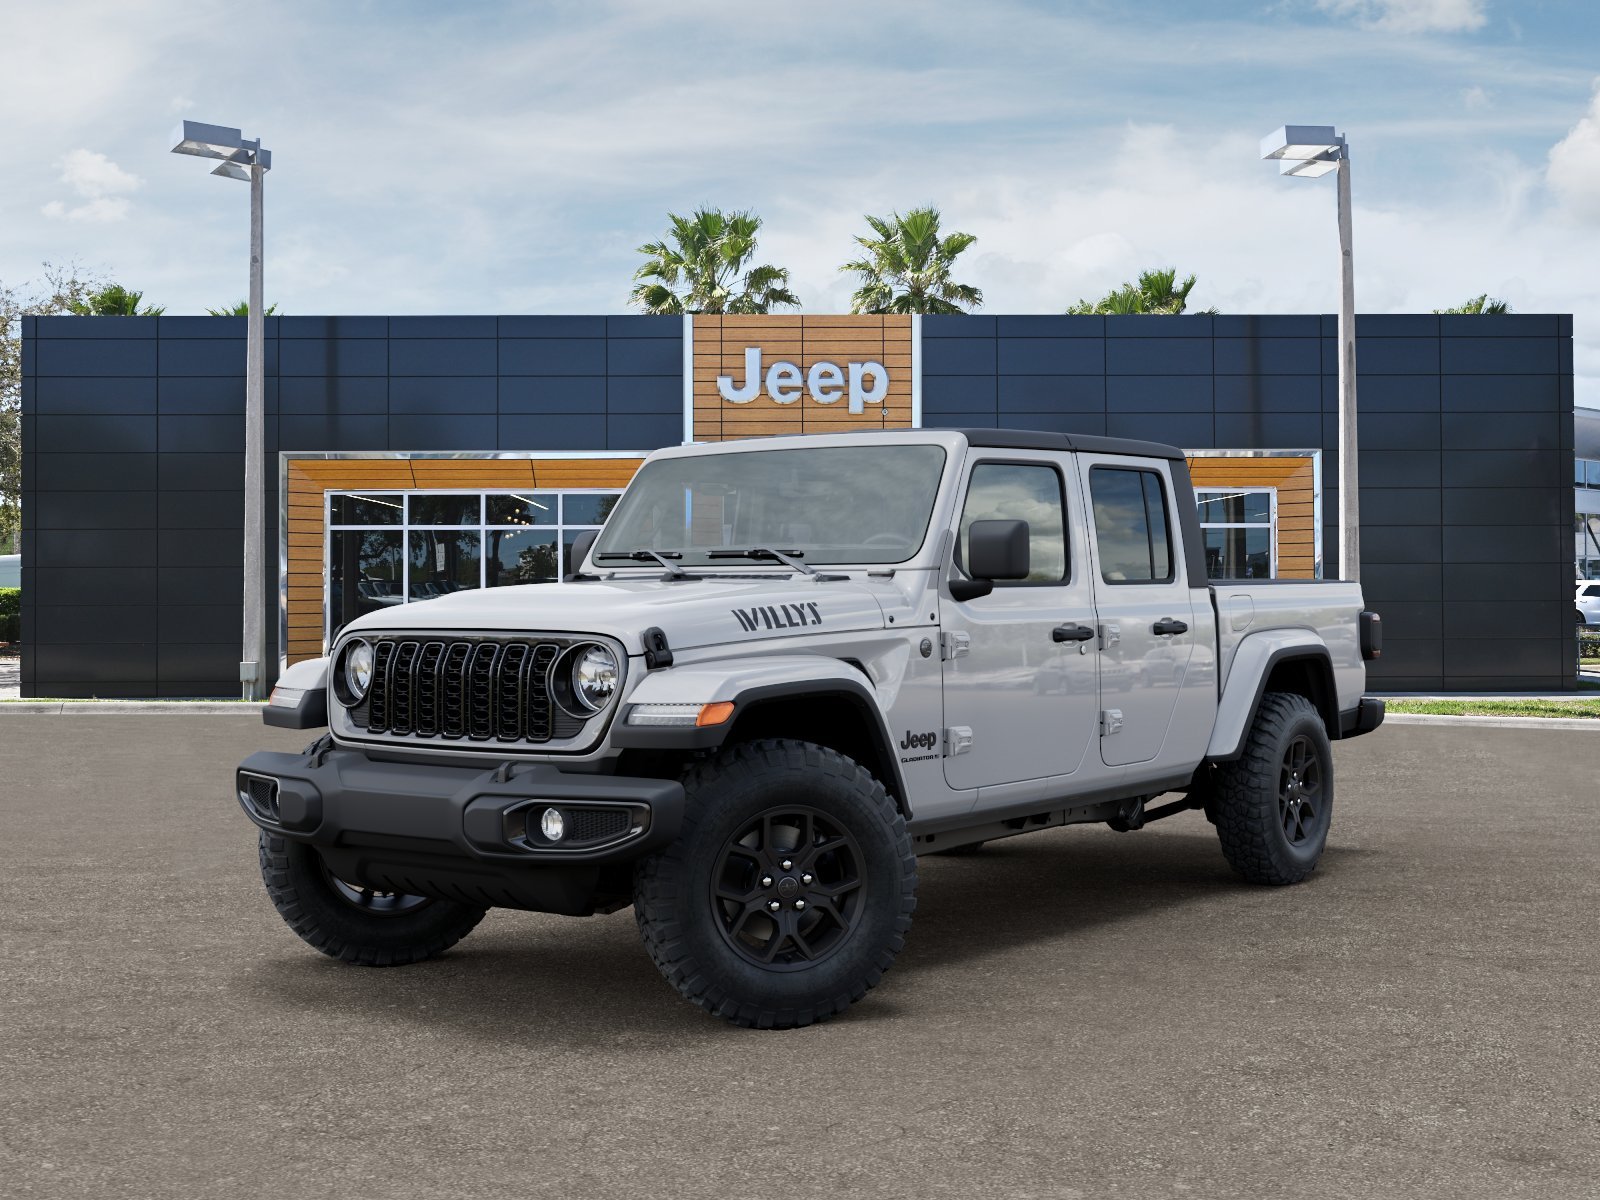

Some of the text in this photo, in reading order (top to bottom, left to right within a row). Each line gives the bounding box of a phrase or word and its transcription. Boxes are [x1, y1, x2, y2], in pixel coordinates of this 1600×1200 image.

[717, 347, 889, 415] Jeep
[730, 602, 822, 632] WILLYS
[900, 730, 937, 750] Jeep
[901, 754, 934, 763] GLADIATOR
